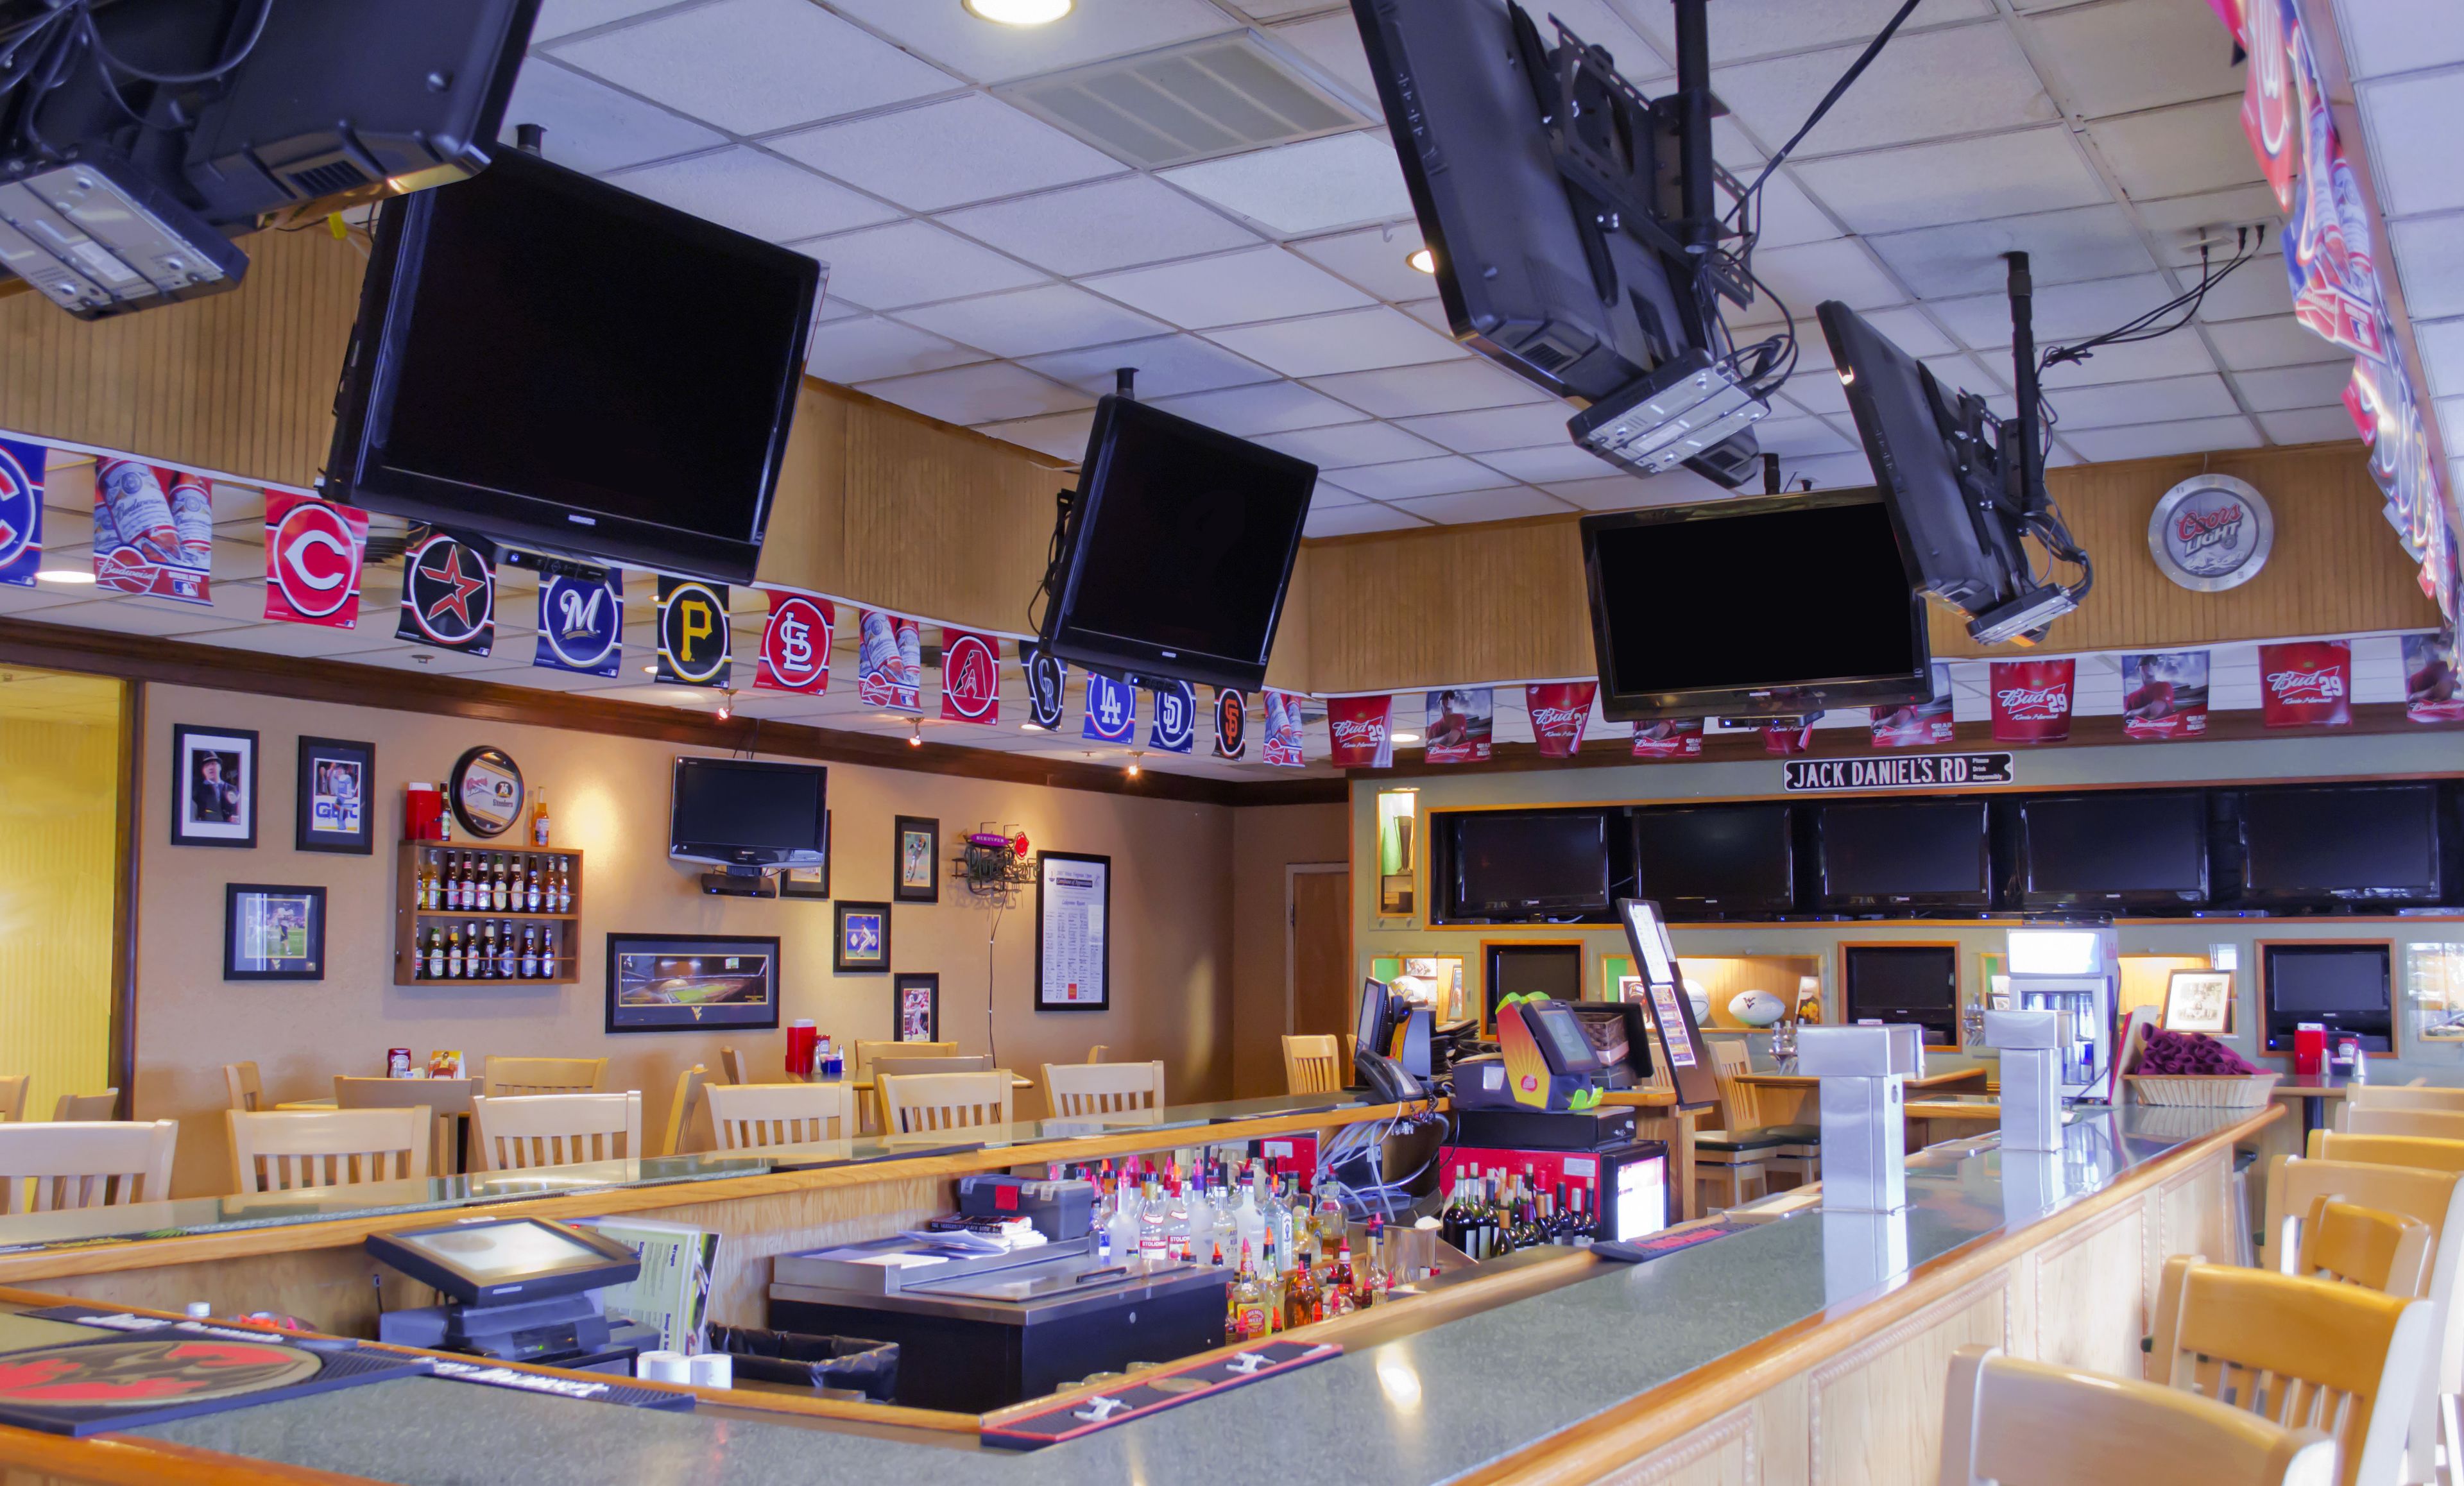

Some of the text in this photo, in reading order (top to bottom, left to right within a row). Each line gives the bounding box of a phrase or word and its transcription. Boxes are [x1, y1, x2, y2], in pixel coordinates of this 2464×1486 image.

[2177, 504, 2242, 541] Coors
[2186, 522, 2240, 556] LIGHT
[97, 561, 159, 580] Budweiser
[284, 529, 346, 590] C
[560, 588, 604, 633] M
[680, 600, 713, 662] P
[860, 683, 893, 696] Budweiser
[2267, 670, 2343, 696] Bud 29
[1100, 676, 1121, 725] LA
[1998, 688, 2067, 713] Bud 29
[1532, 708, 1575, 724] Bud
[1332, 720, 1385, 742] Bud 29
[1794, 762, 1845, 787] JACK
[1941, 758, 1967, 782] RD
